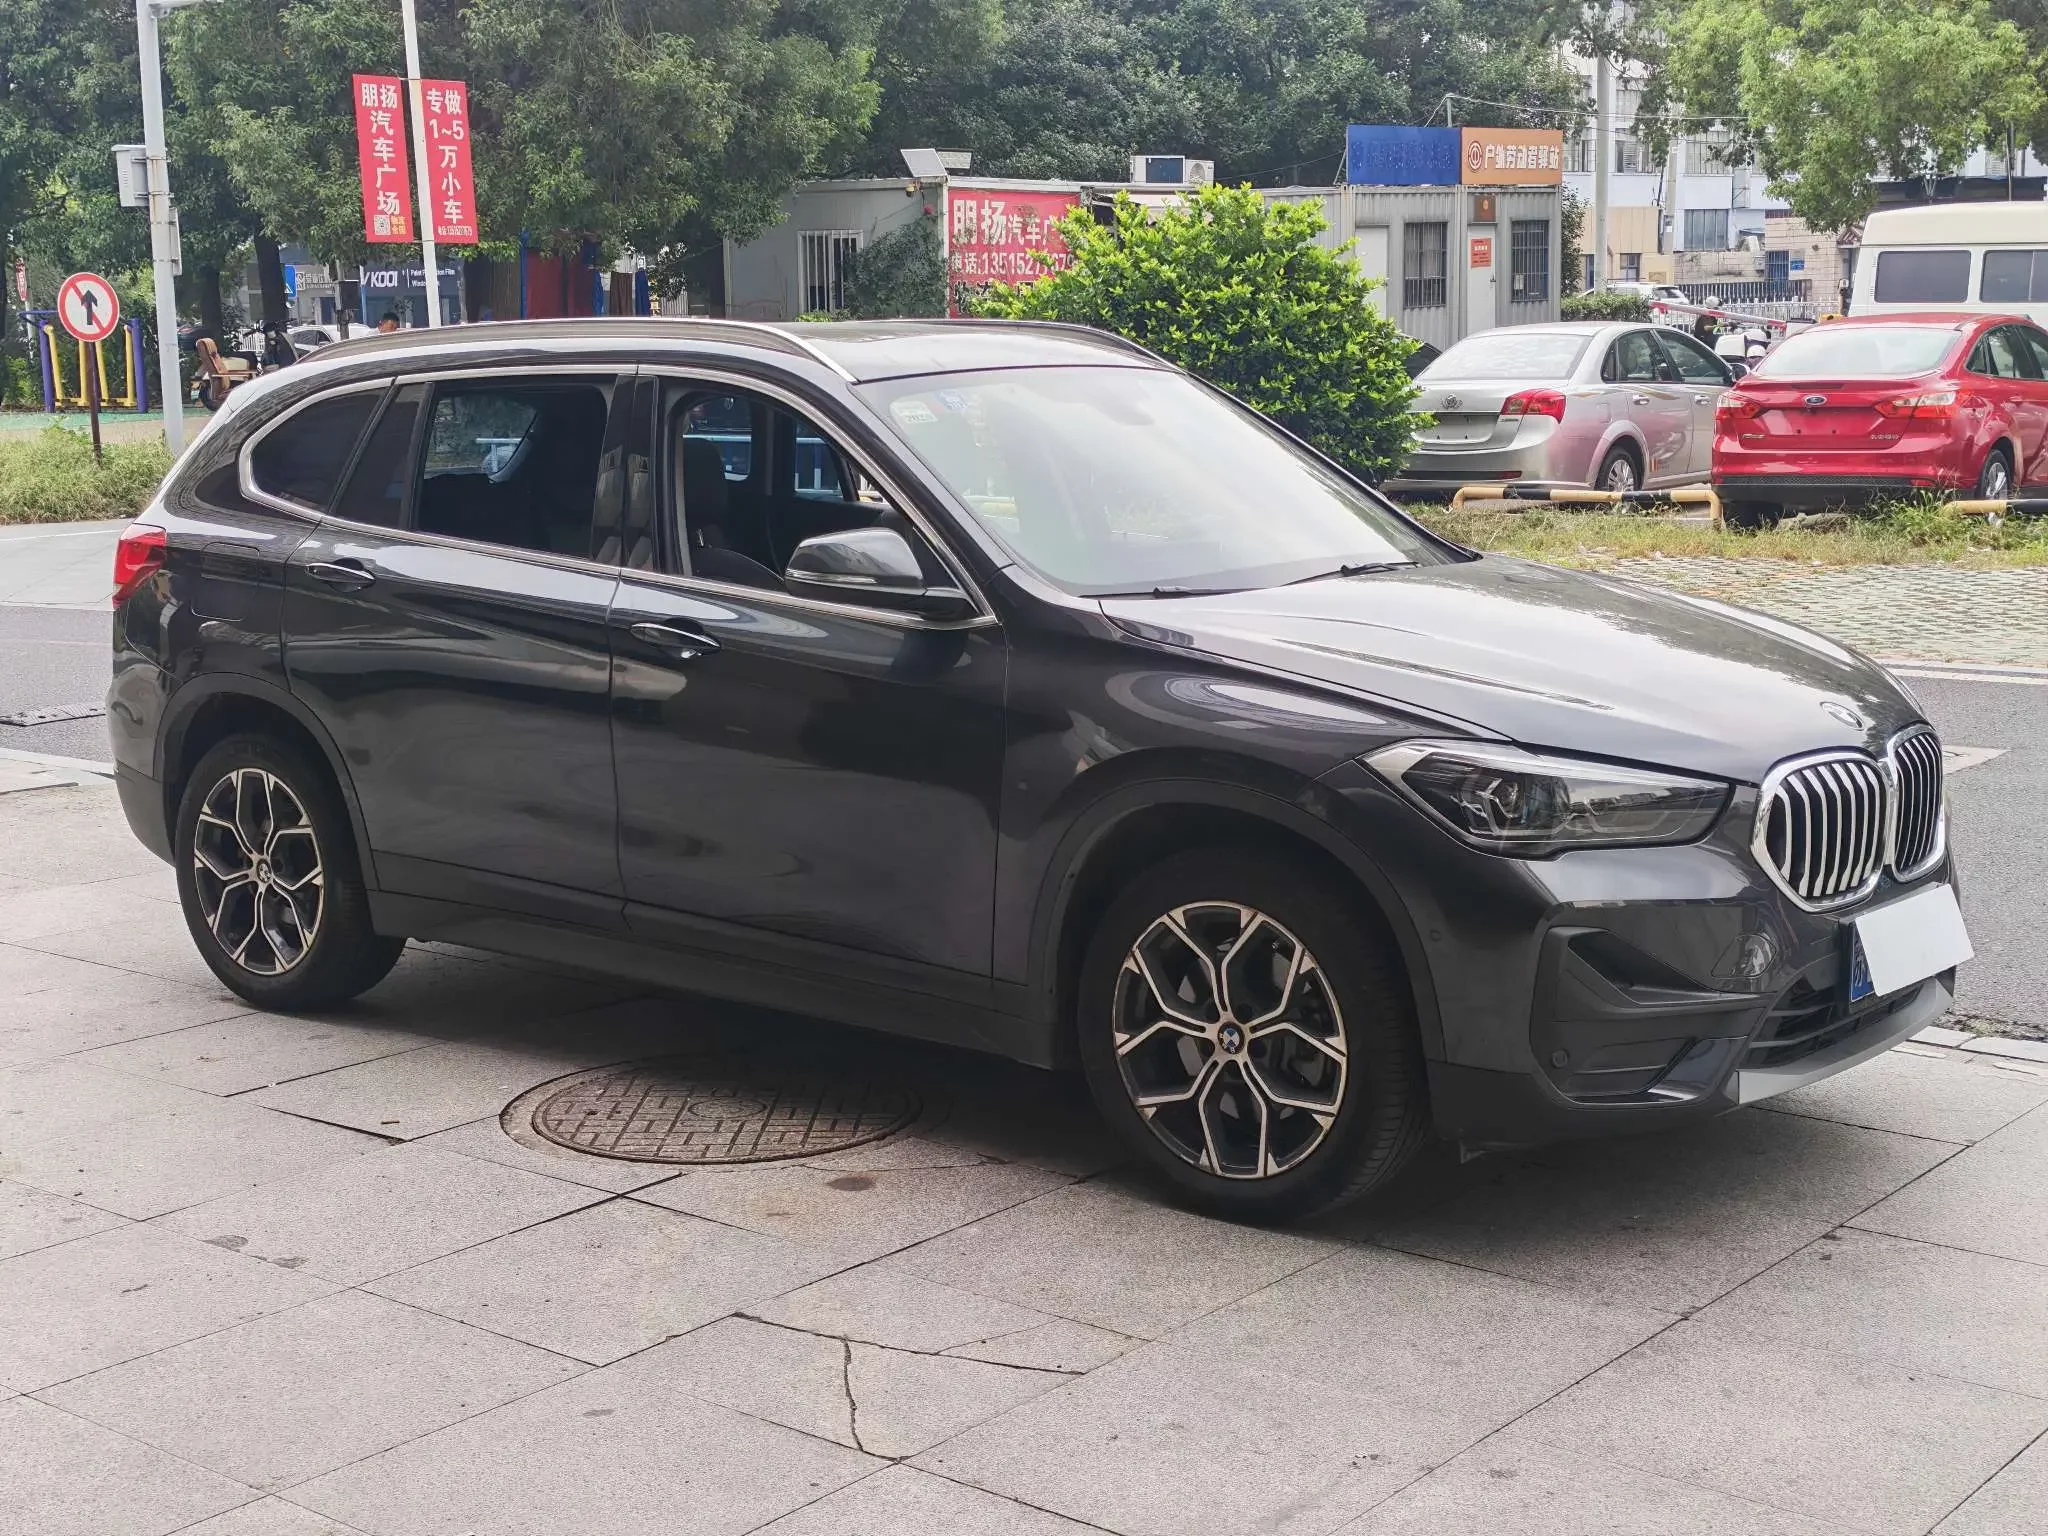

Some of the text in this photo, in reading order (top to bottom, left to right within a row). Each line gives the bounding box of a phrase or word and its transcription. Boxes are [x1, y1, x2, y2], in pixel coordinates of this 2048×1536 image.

[1484, 144, 1560, 169] 户外劳动者驿站
[953, 200, 1066, 246] 朋扬汽车广
